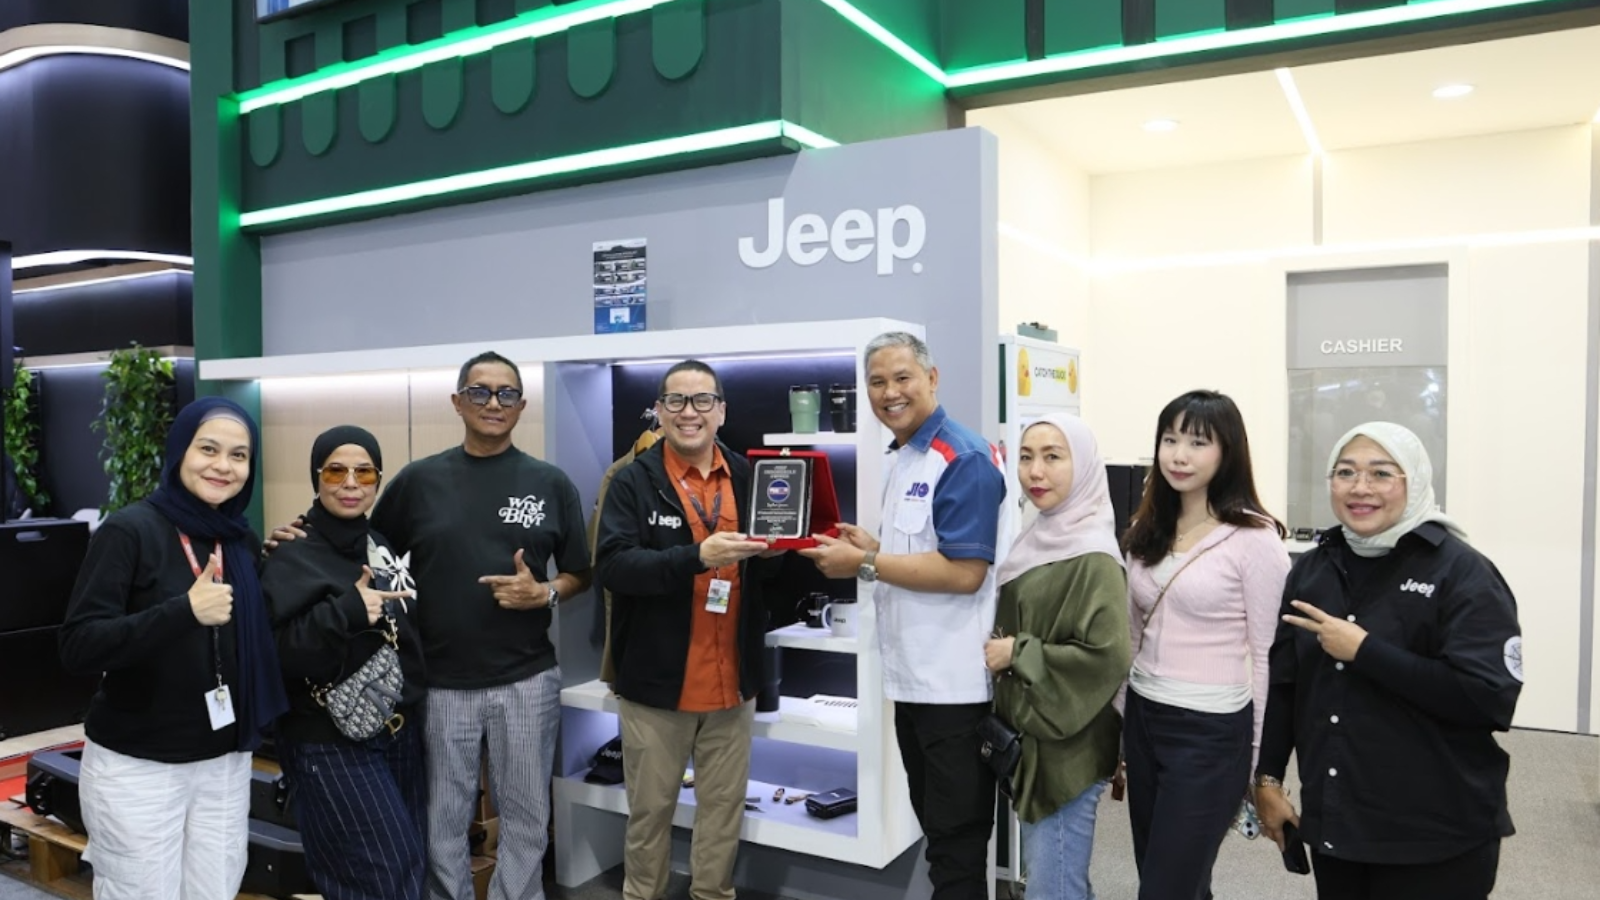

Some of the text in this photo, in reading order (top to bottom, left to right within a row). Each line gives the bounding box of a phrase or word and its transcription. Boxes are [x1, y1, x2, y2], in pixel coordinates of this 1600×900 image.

[1320, 338, 1403, 354] CASHIER
[648, 510, 682, 529] Jeep
[1400, 578, 1435, 598] Jeep
